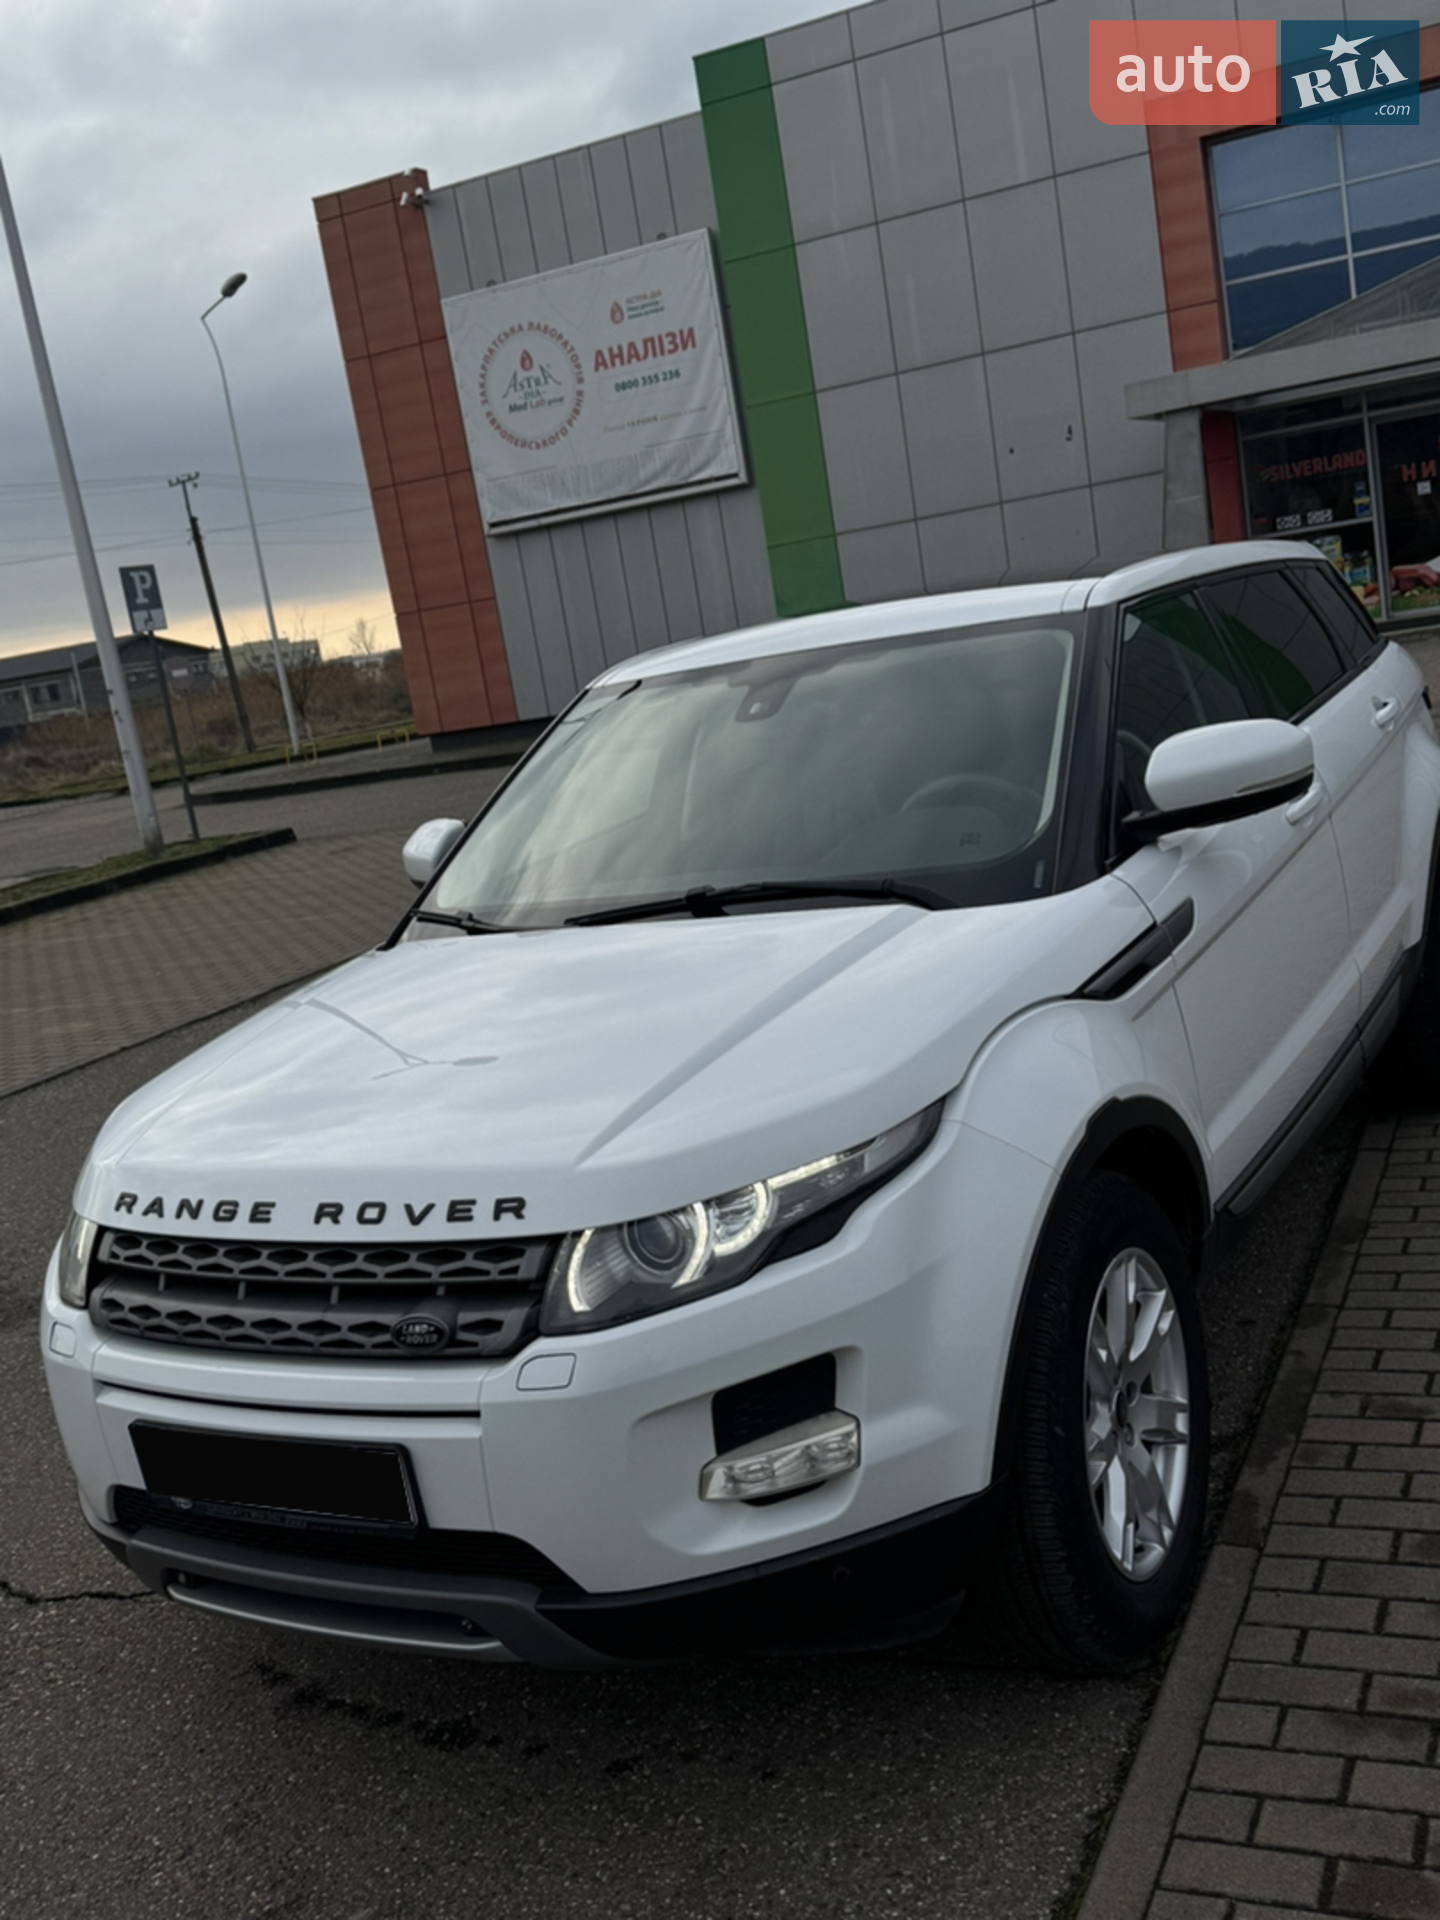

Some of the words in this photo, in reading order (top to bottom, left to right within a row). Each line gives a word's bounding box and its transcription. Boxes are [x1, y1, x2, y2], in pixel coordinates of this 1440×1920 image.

[526, 320, 585, 384] ЛАБОРАТОРІЯ
[593, 326, 697, 372] АНАЛІЗИ
[613, 377, 640, 393] 0800
[641, 372, 660, 388] 355
[662, 369, 681, 384] 236
[1269, 449, 1366, 483] SILVERLAND
[129, 570, 153, 604] P
[114, 1191, 277, 1225] RANGE
[313, 1195, 529, 1226] ROVER
[402, 1323, 429, 1334] LAND
[405, 1334, 438, 1345] ROVER
